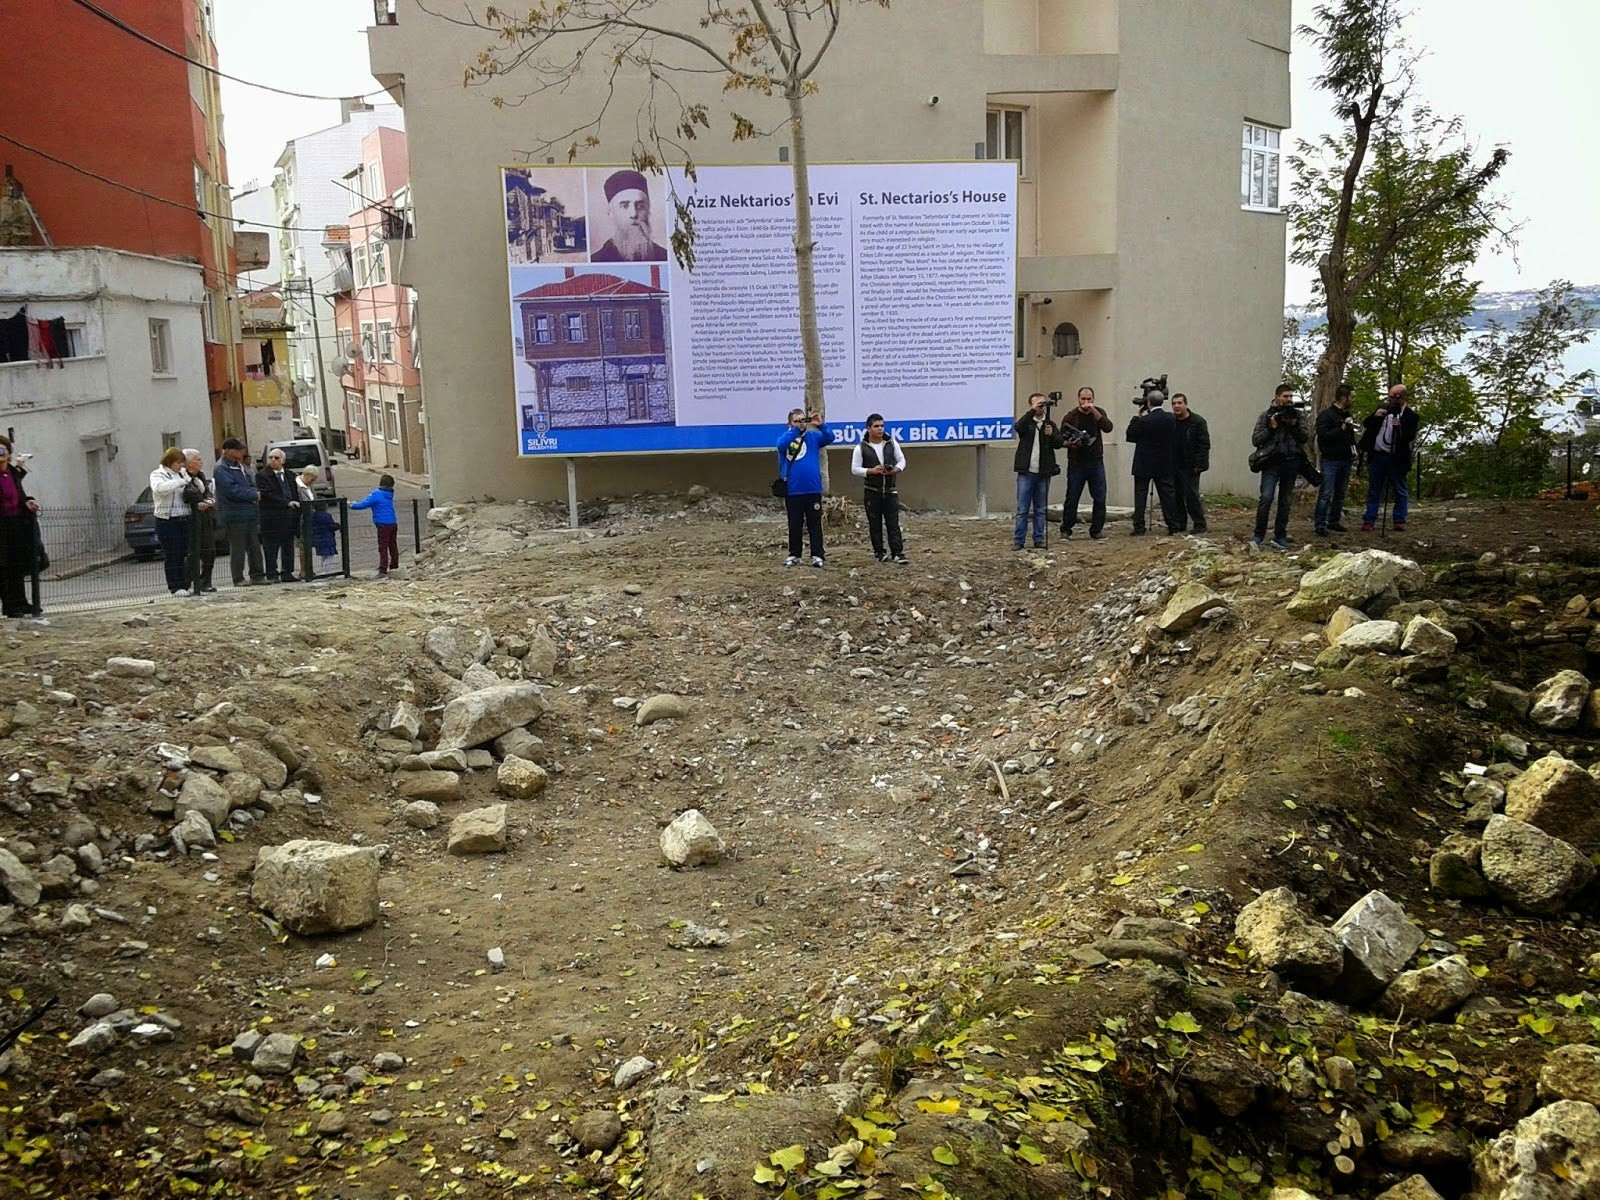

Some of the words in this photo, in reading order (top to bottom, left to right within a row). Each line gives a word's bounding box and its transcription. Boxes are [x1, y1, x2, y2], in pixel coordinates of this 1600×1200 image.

[686, 195, 717, 208] Aziz
[720, 193, 814, 208] Nektarios'n
[817, 192, 839, 206] Evi
[859, 192, 878, 205] St.
[881, 190, 958, 205] Nectarios's
[962, 190, 1007, 203] House
[832, 424, 904, 443] BÜYK
[909, 422, 939, 441] BİR
[945, 420, 1012, 440] AİLEYİZ
